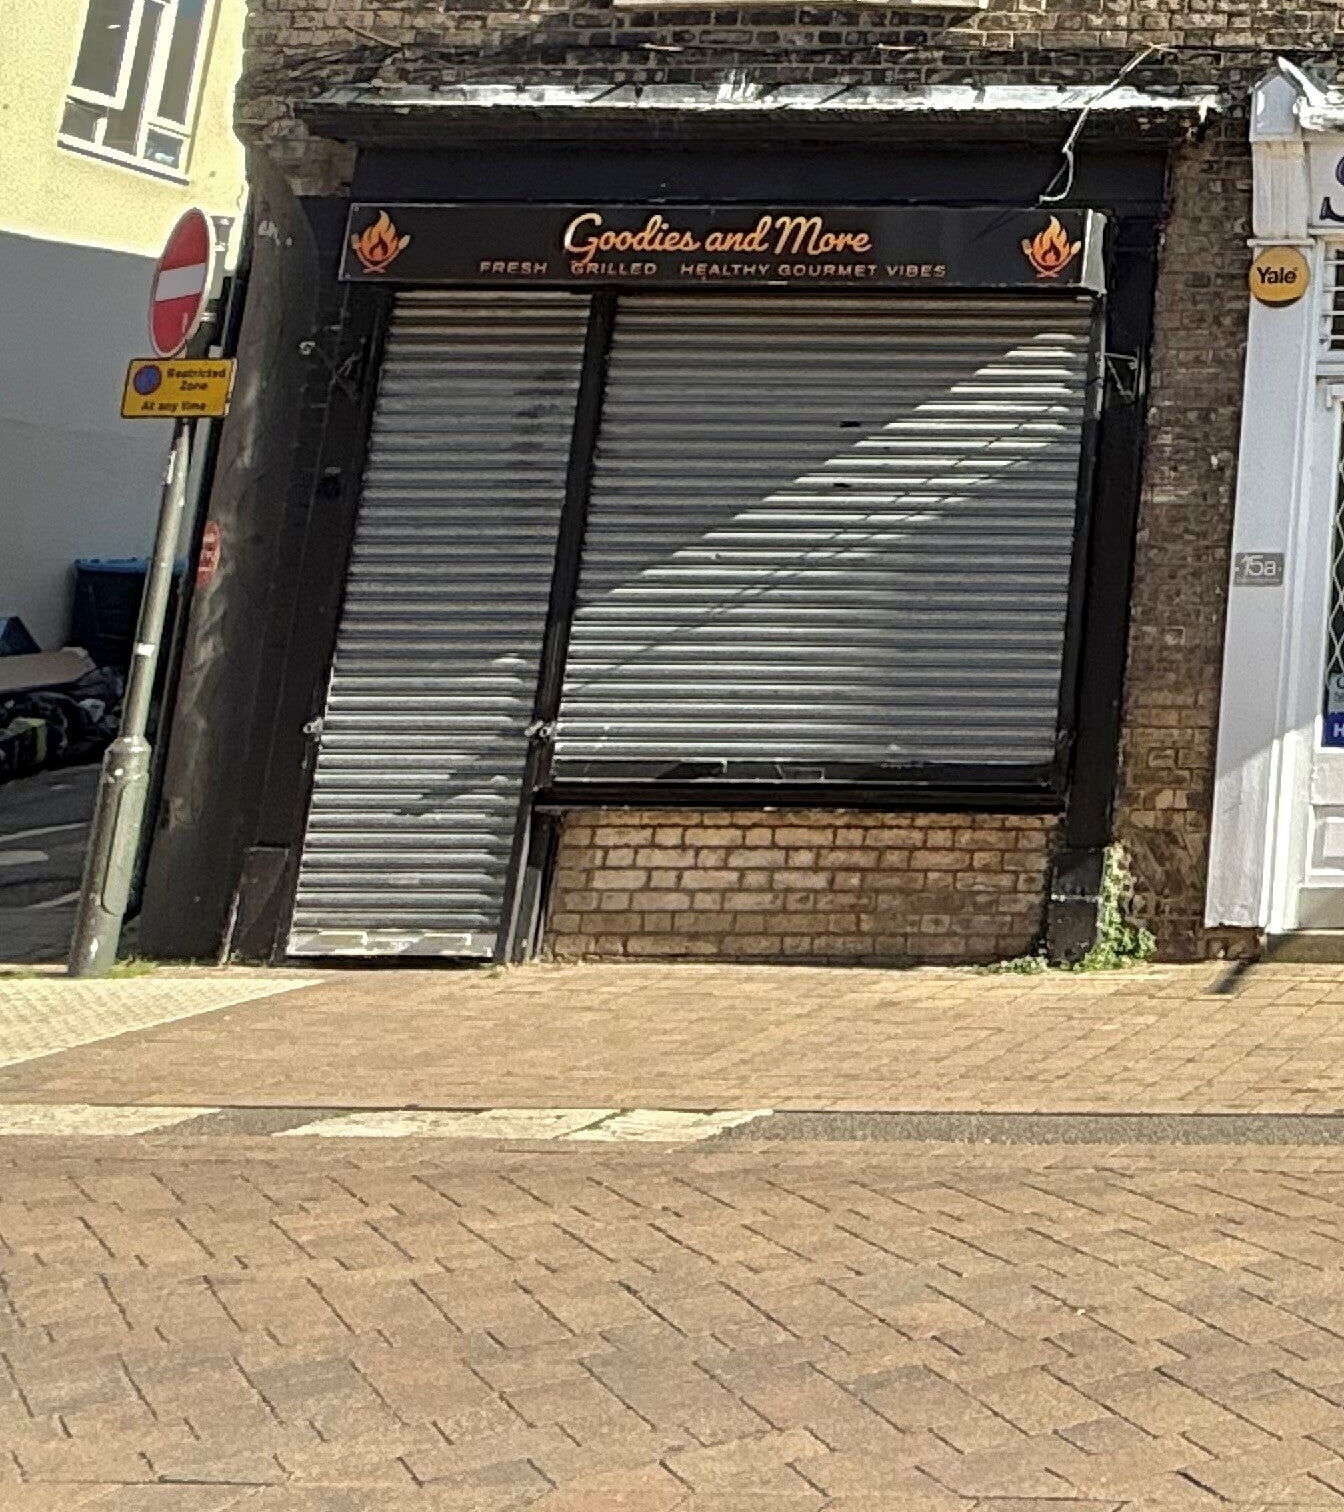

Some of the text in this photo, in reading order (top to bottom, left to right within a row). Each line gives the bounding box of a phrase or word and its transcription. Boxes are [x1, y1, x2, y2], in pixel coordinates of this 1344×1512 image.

[563, 212, 872, 264] Goodies and More
[480, 261, 946, 277] FRESH GRILLED HEALTHY GOURMET VIBES
[1257, 267, 1297, 284] Yale
[159, 402, 178, 413] any
[181, 401, 207, 411] time
[1240, 555, 1276, 576] 15a
